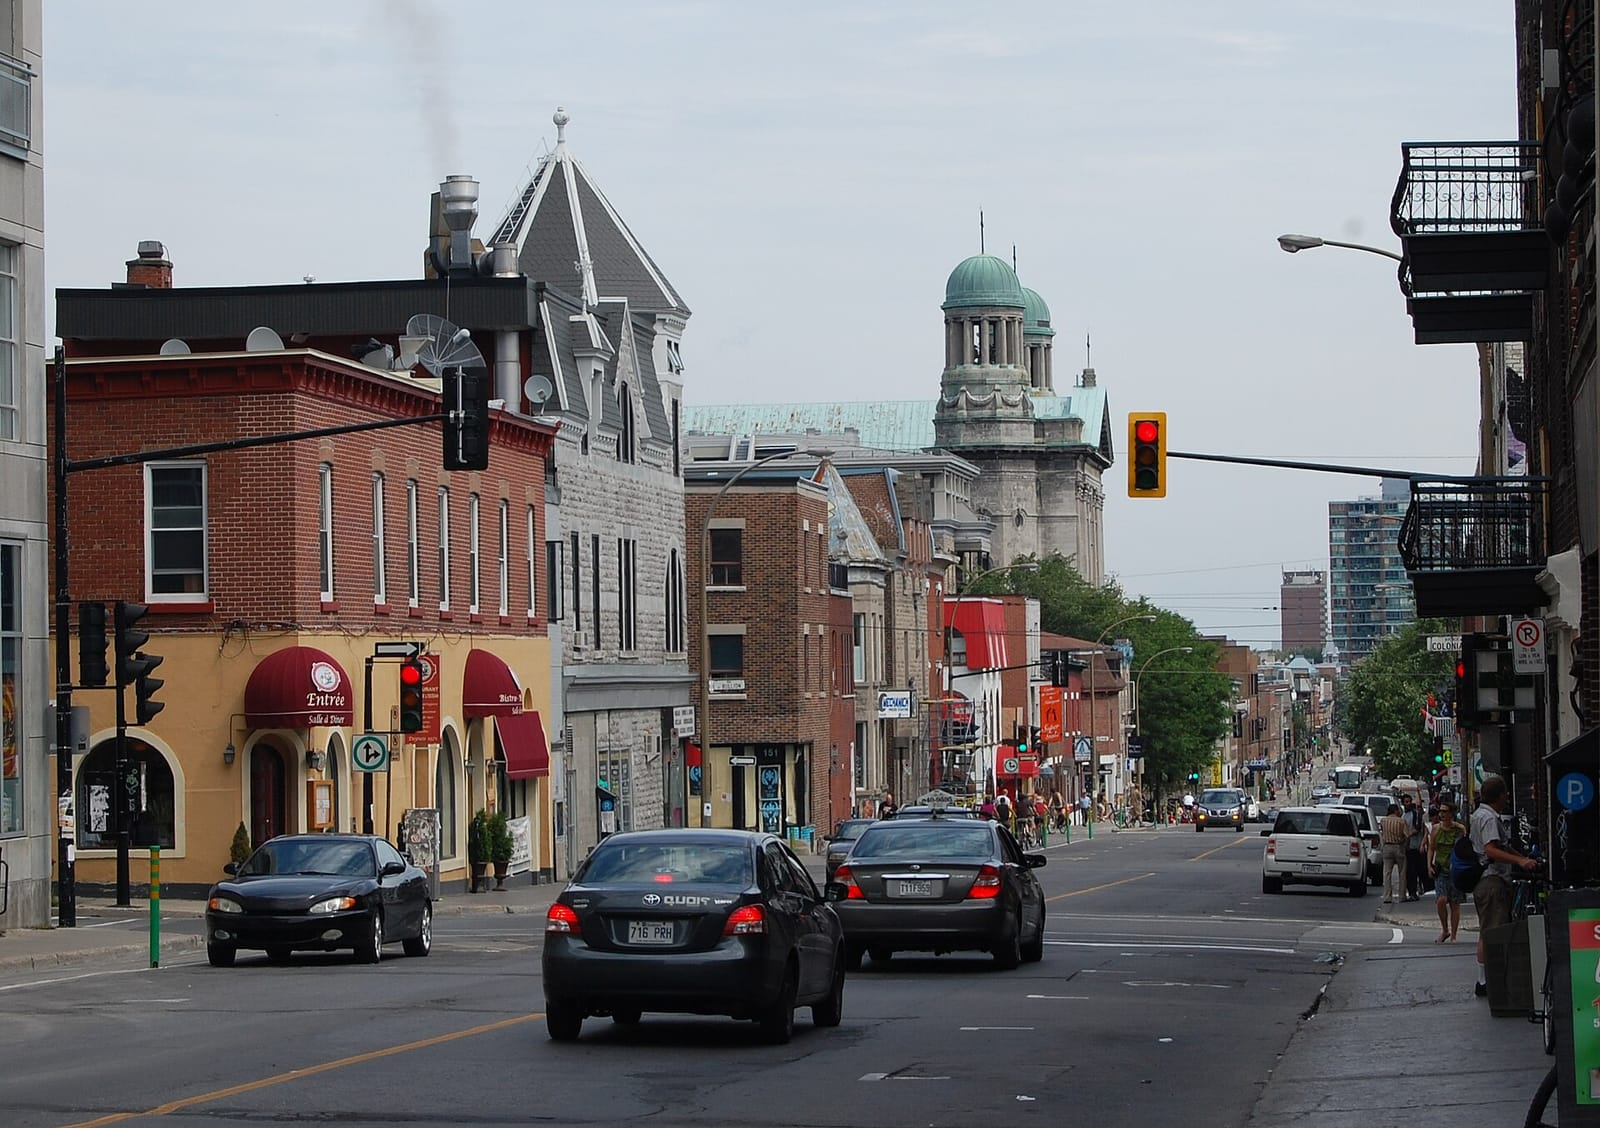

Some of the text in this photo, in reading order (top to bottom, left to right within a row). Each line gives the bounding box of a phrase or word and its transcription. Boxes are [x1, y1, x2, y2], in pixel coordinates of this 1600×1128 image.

[306, 692, 345, 706] Entrée
[631, 927, 672, 939] 716 PRH
